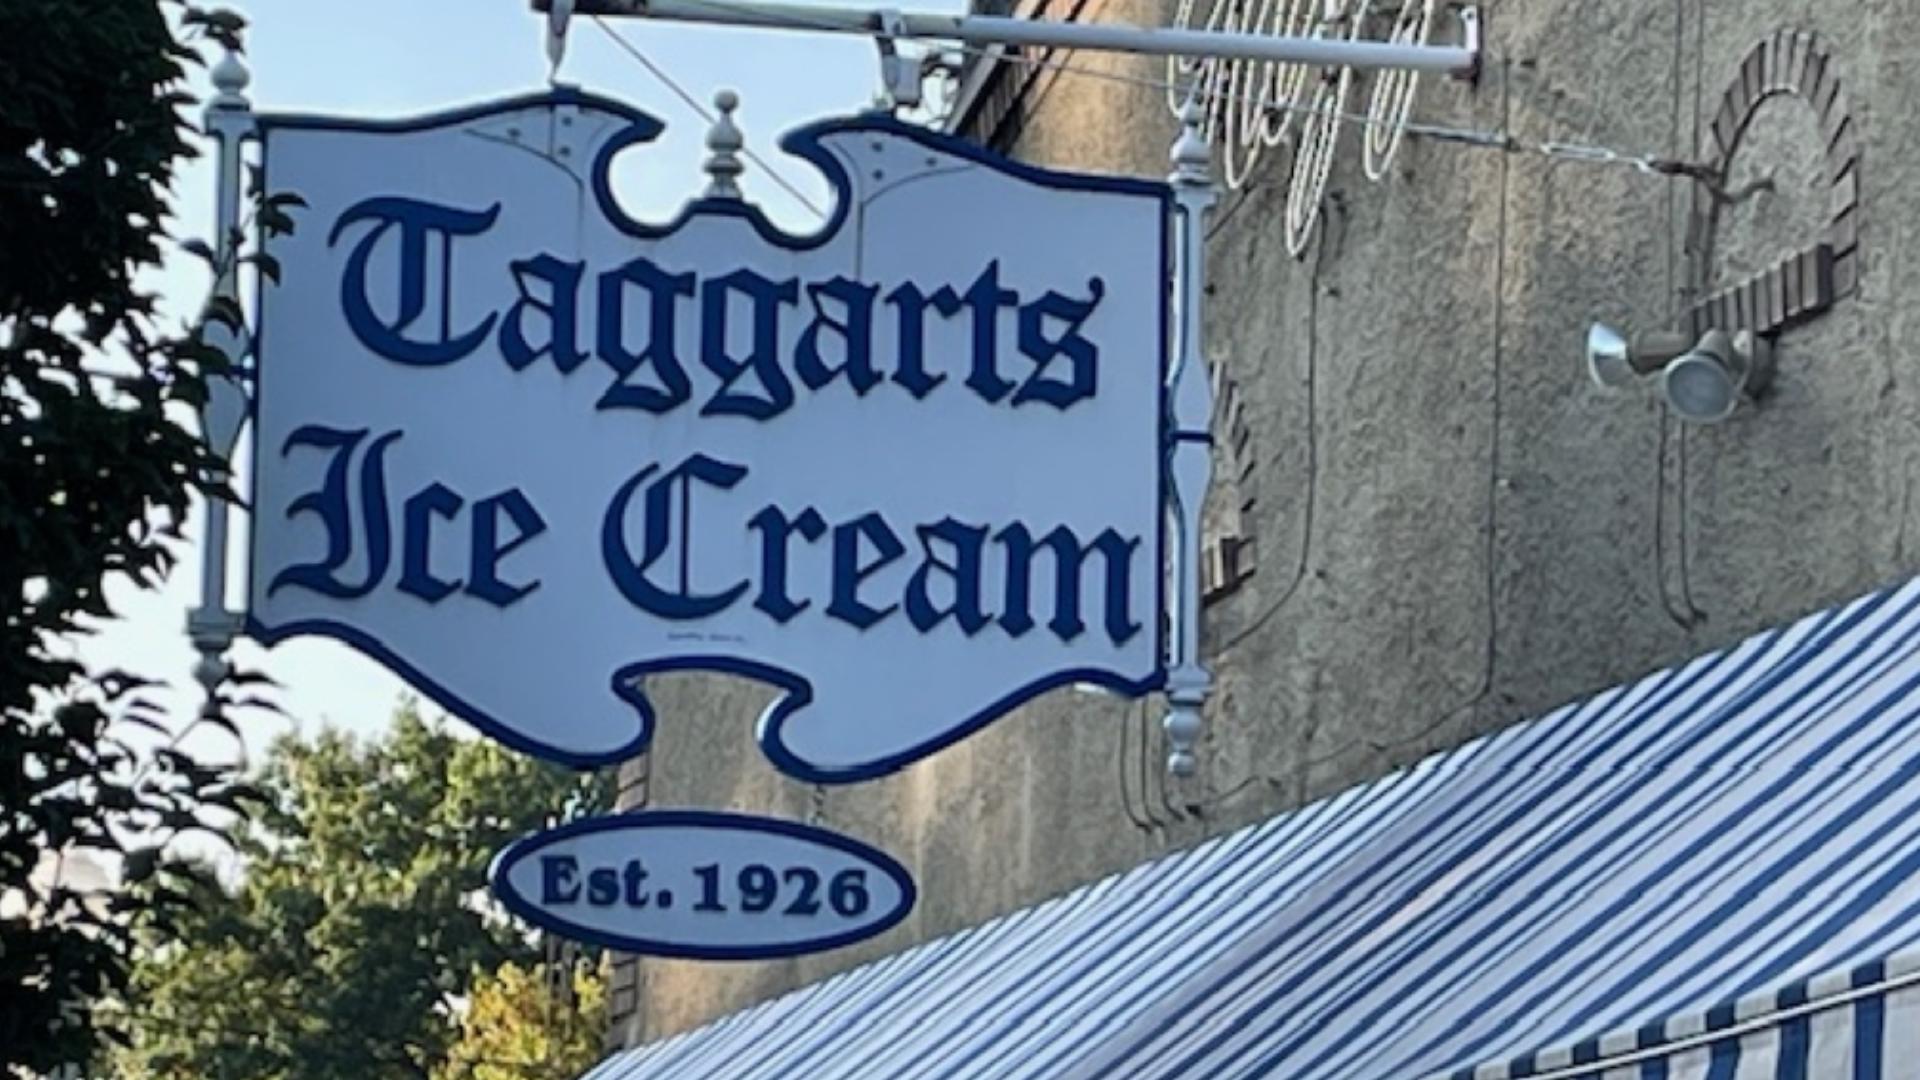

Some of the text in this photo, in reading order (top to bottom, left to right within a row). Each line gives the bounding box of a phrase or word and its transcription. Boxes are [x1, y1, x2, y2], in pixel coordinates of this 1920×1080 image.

[267, 425, 1142, 646] Ice Cream
[540, 855, 870, 918] Est. 1926
